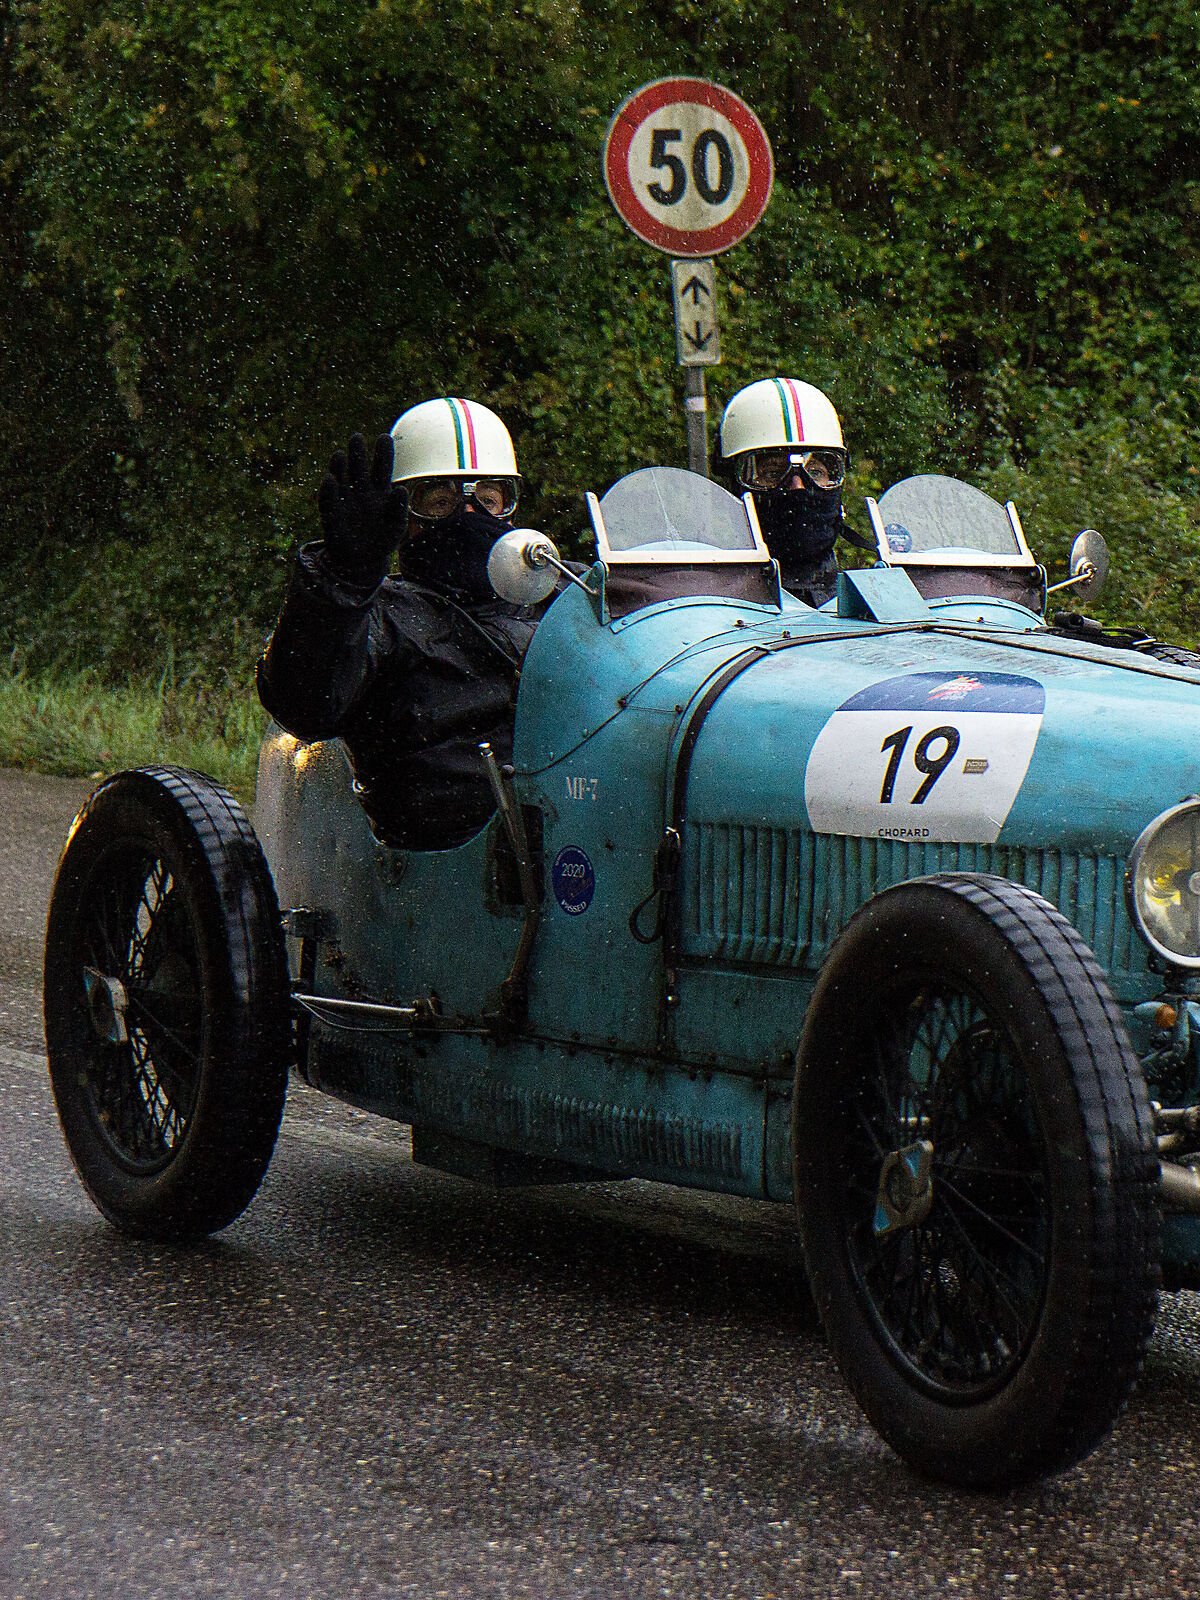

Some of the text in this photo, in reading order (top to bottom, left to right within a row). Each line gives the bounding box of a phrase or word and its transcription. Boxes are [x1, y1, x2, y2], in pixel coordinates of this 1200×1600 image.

[646, 128, 735, 206] 50
[880, 725, 961, 804] 19
[878, 828, 930, 837] CHOPARD
[562, 863, 586, 878] 2020
